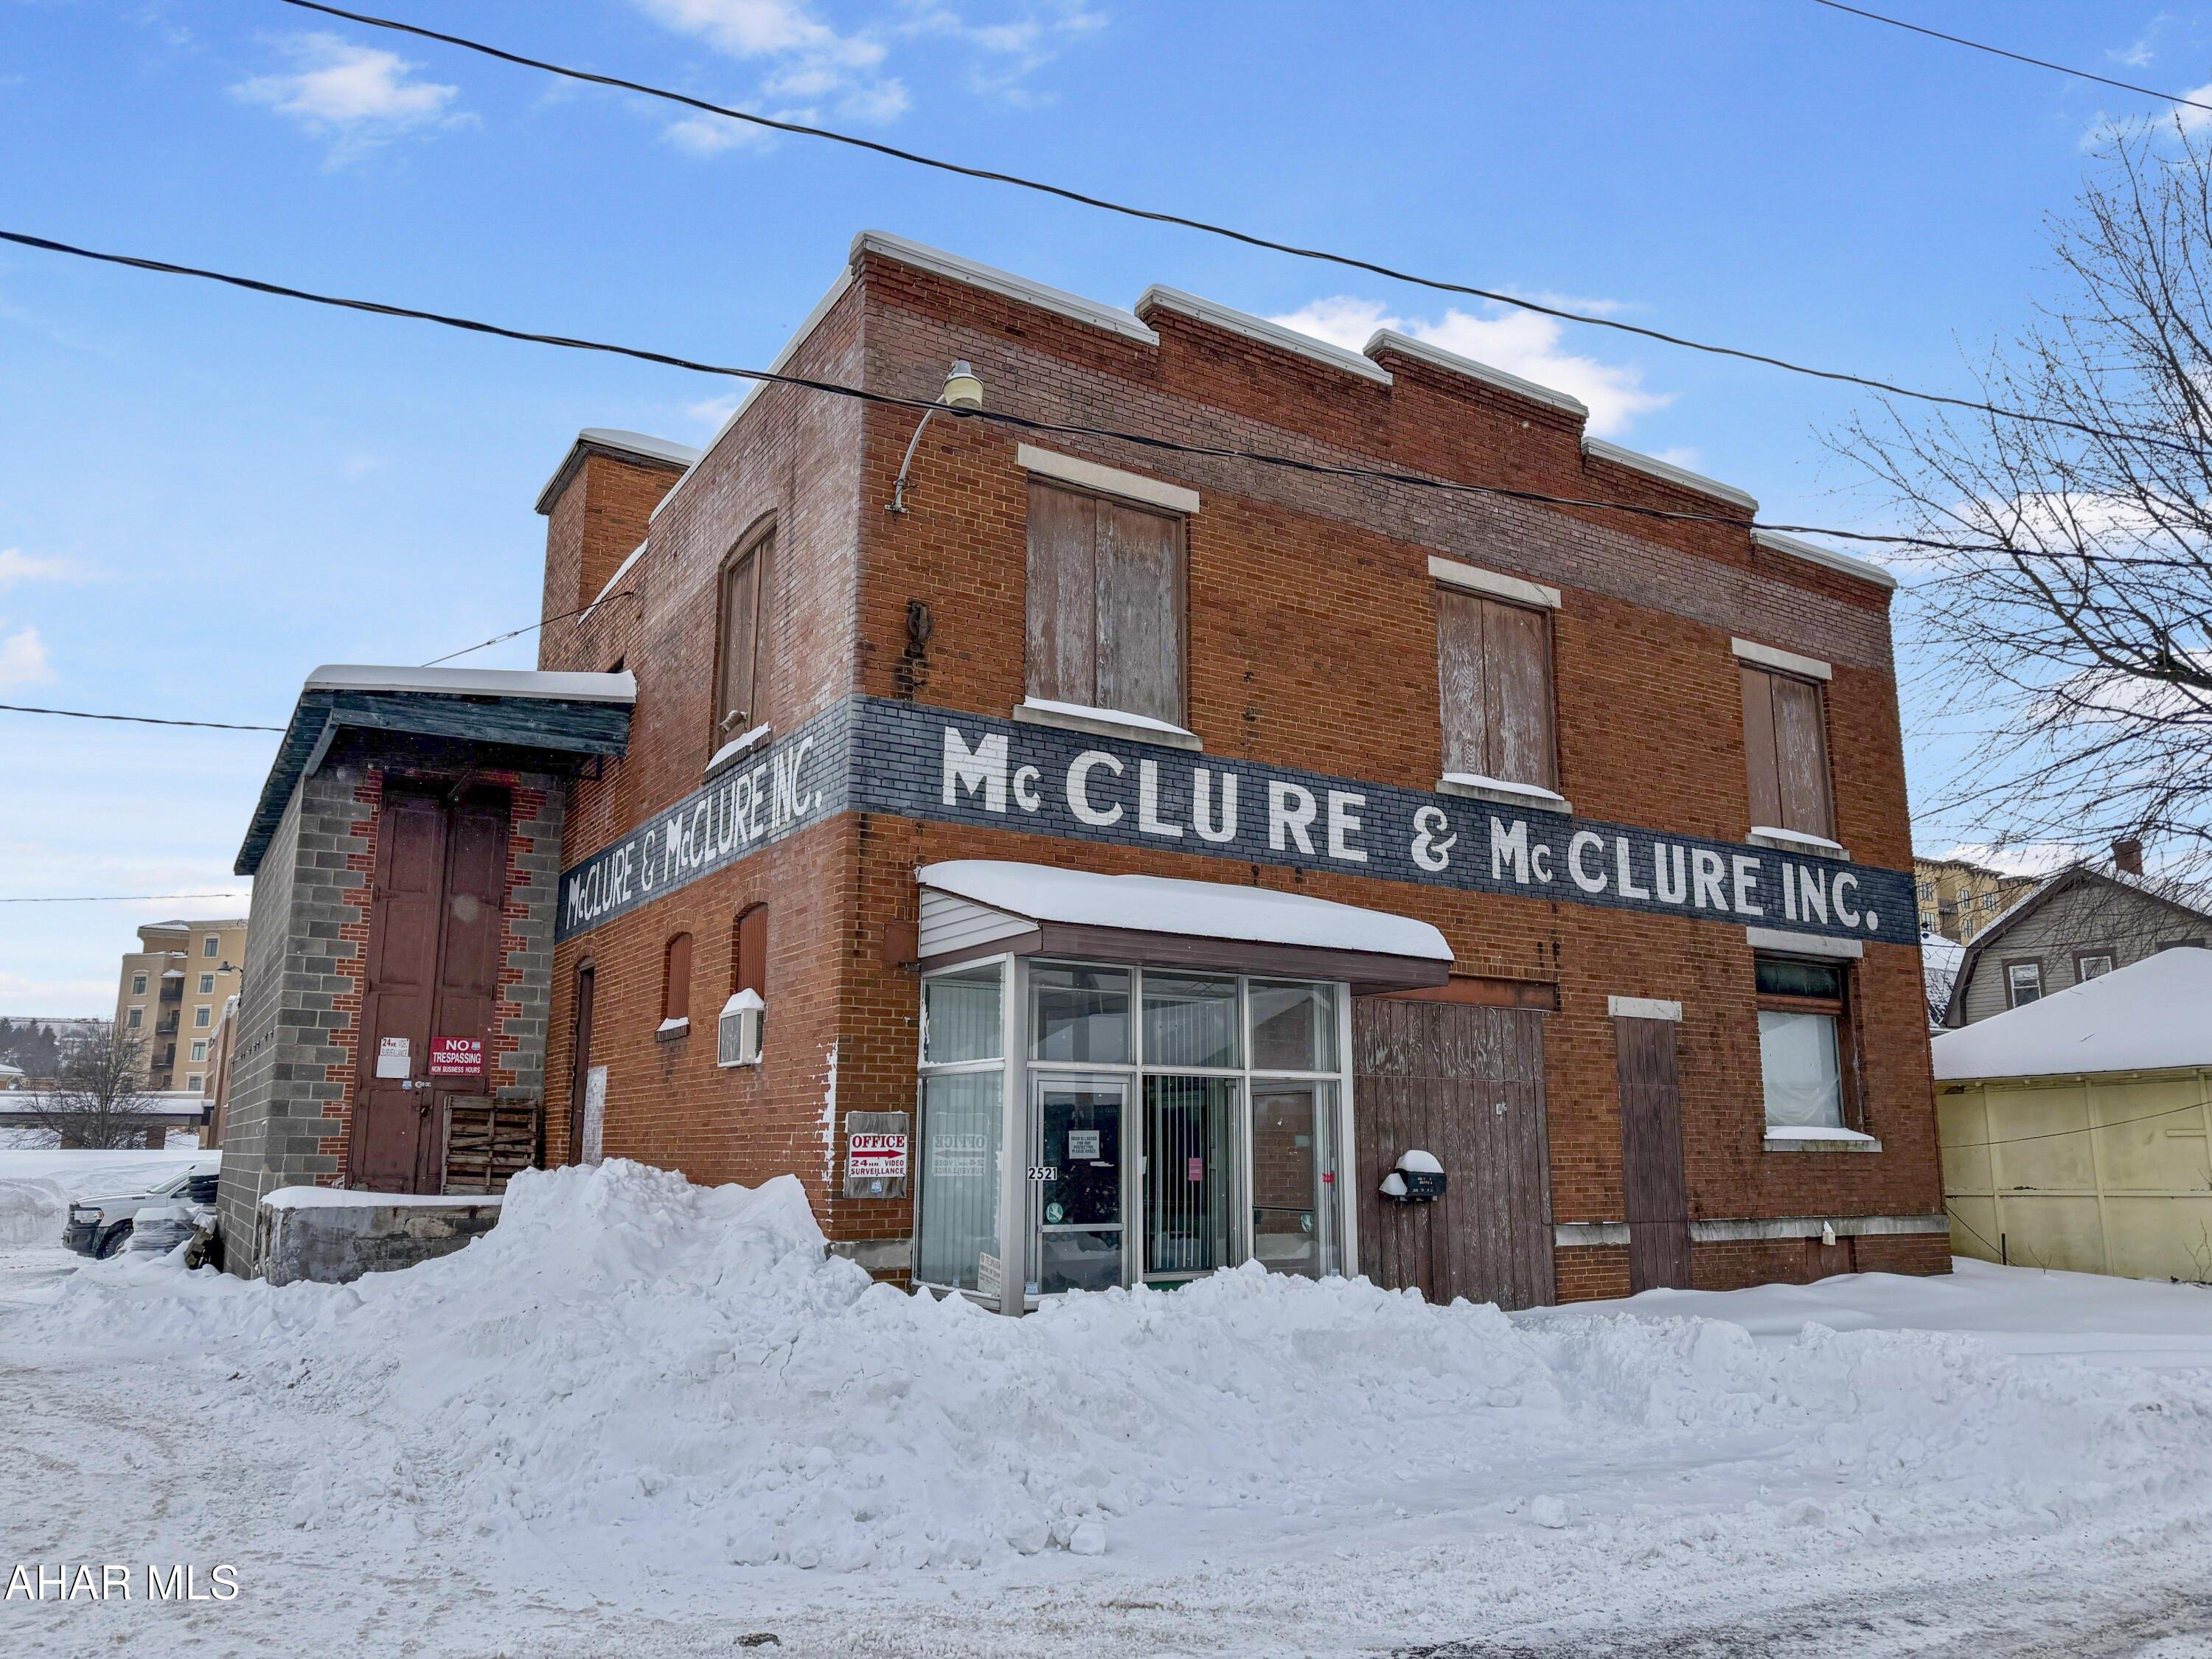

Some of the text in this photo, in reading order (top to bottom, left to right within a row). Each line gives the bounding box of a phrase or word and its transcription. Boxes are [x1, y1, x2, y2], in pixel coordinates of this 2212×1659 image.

[641, 830, 655, 891] &
[771, 735, 822, 829] INC.
[1411, 806, 1457, 872] &
[1781, 862, 1878, 931] INC.
[445, 1040, 470, 1051] NO
[433, 1052, 481, 1064] TRESPASSING
[852, 1135, 905, 1148] OFFICE
[1029, 1167, 1057, 1180] 2521
